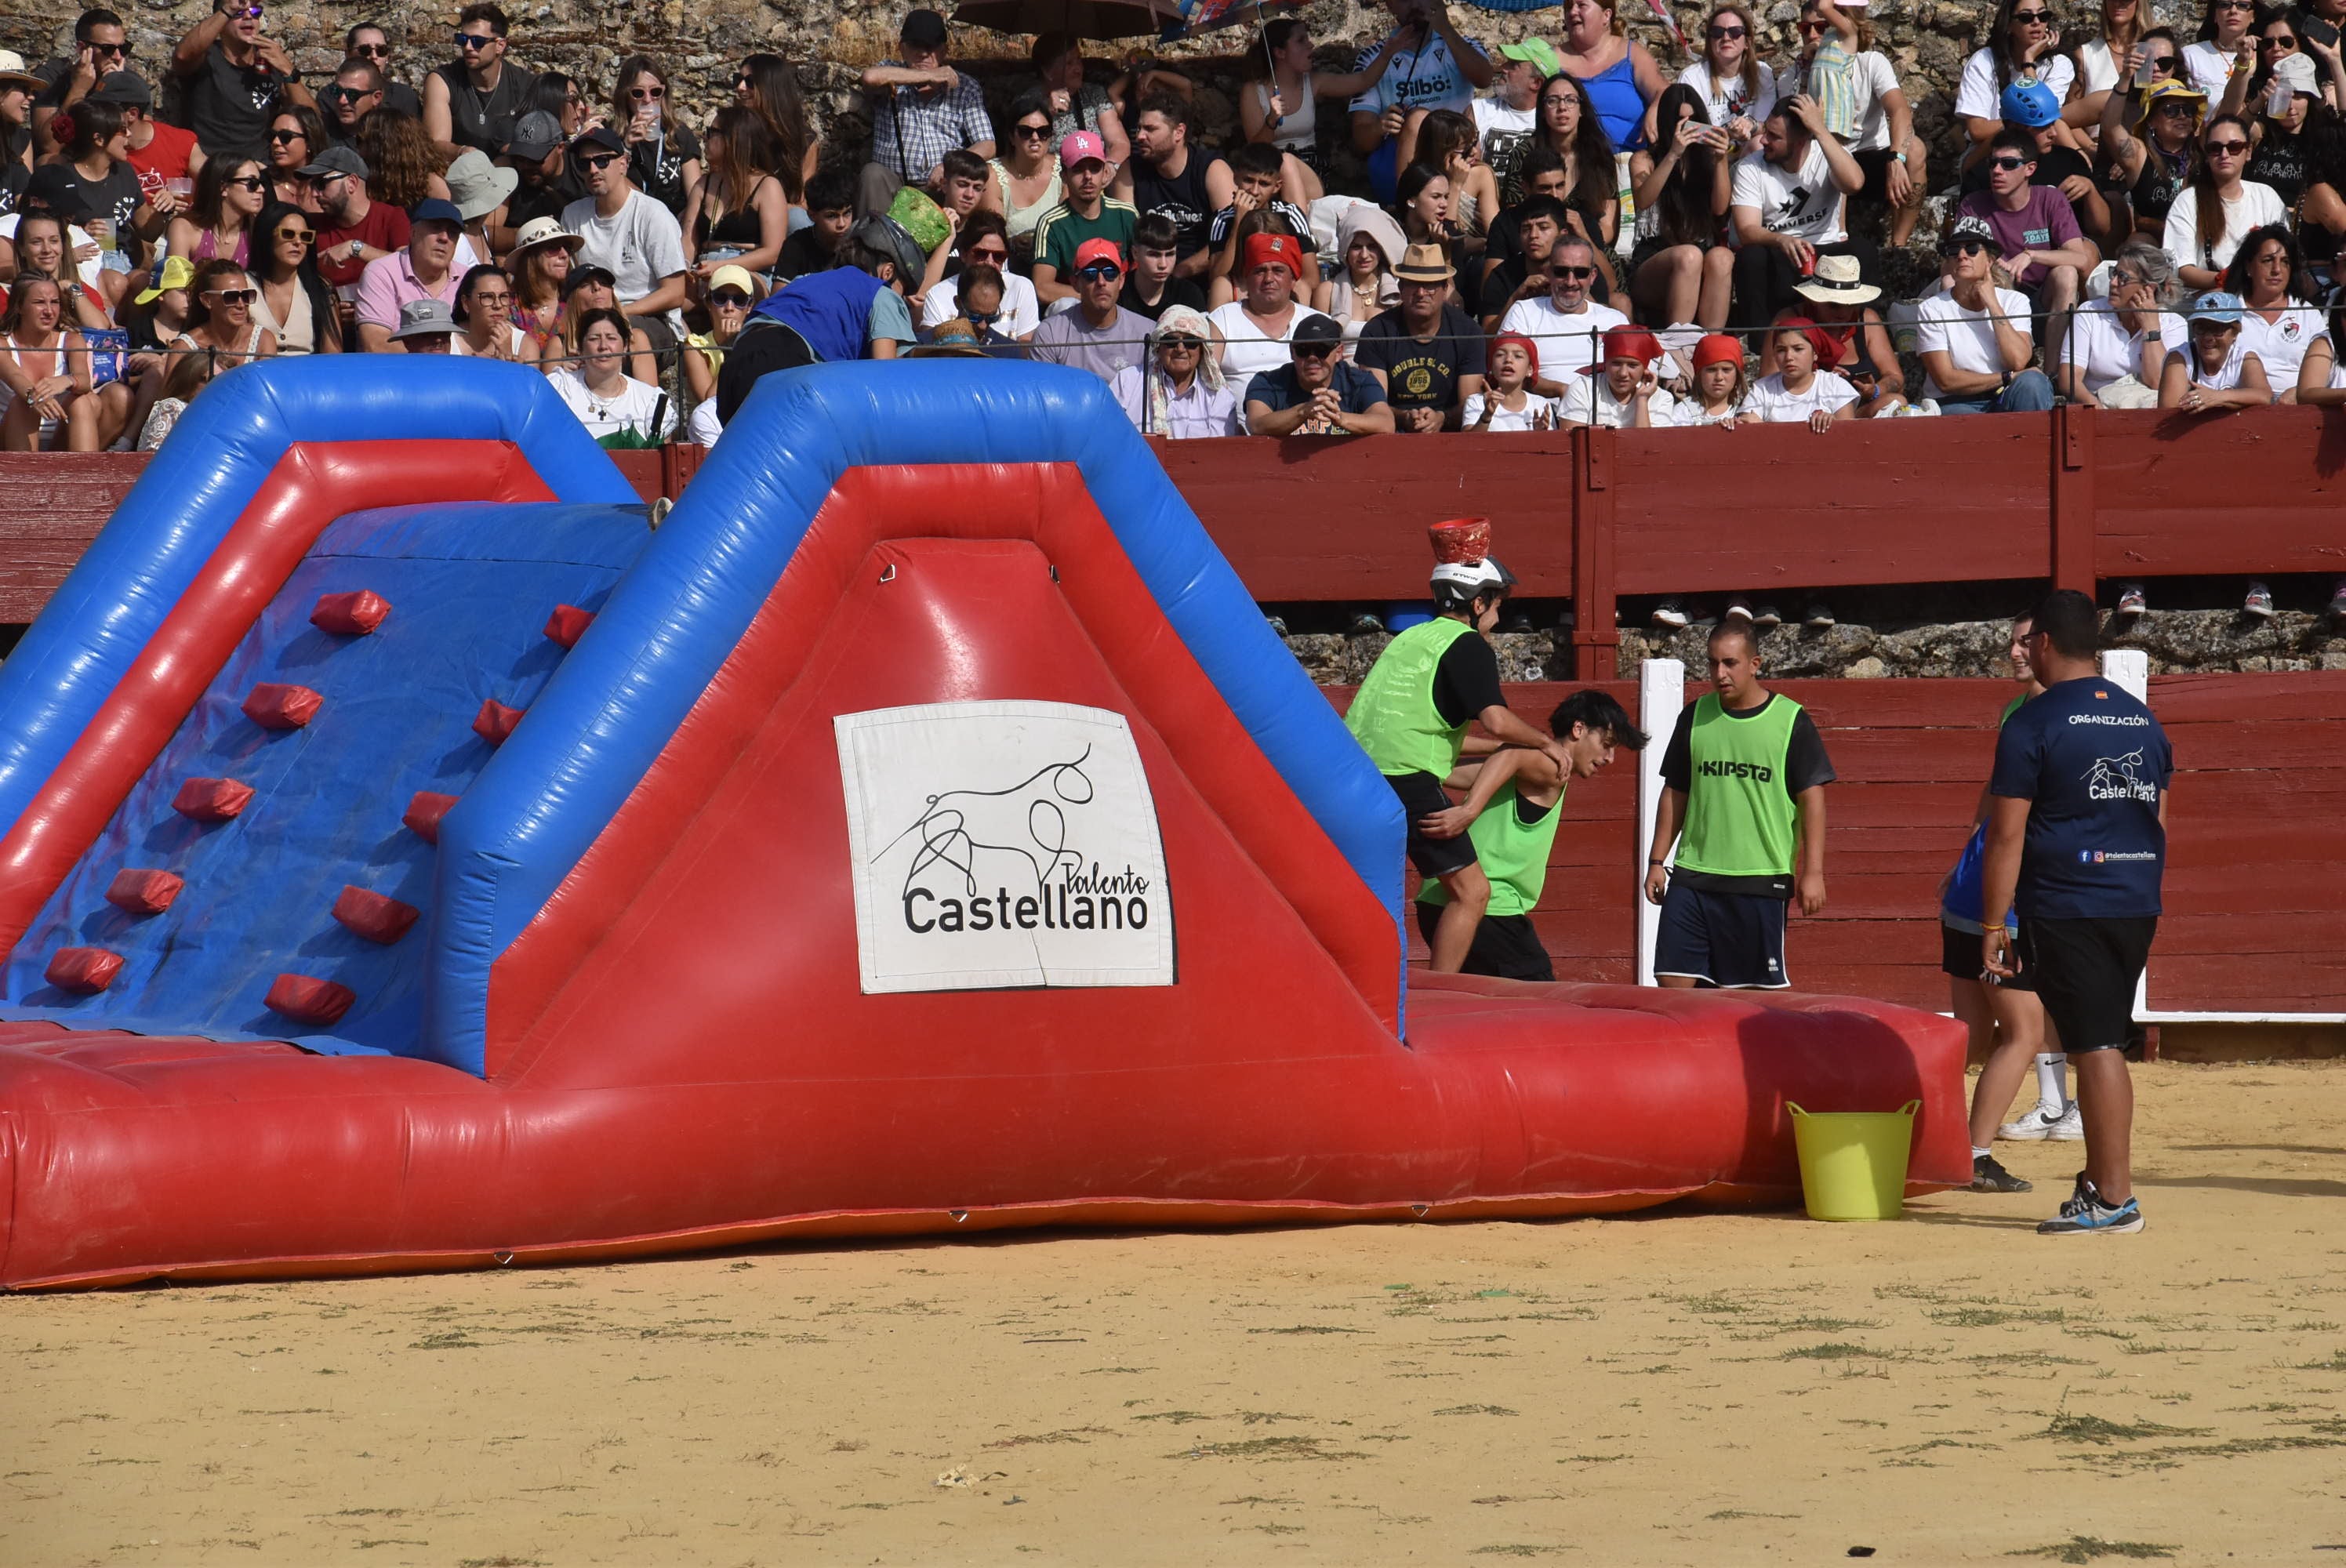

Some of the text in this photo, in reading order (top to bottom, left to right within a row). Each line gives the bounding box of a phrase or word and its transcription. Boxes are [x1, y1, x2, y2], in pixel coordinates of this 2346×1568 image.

[1075, 135, 1090, 150] LA
[1391, 357, 1425, 378] DOUBLE
[2068, 714, 2149, 726] ORGANIZACIÓN
[1060, 861, 1150, 896] Talento
[903, 883, 1149, 934] Castellano
